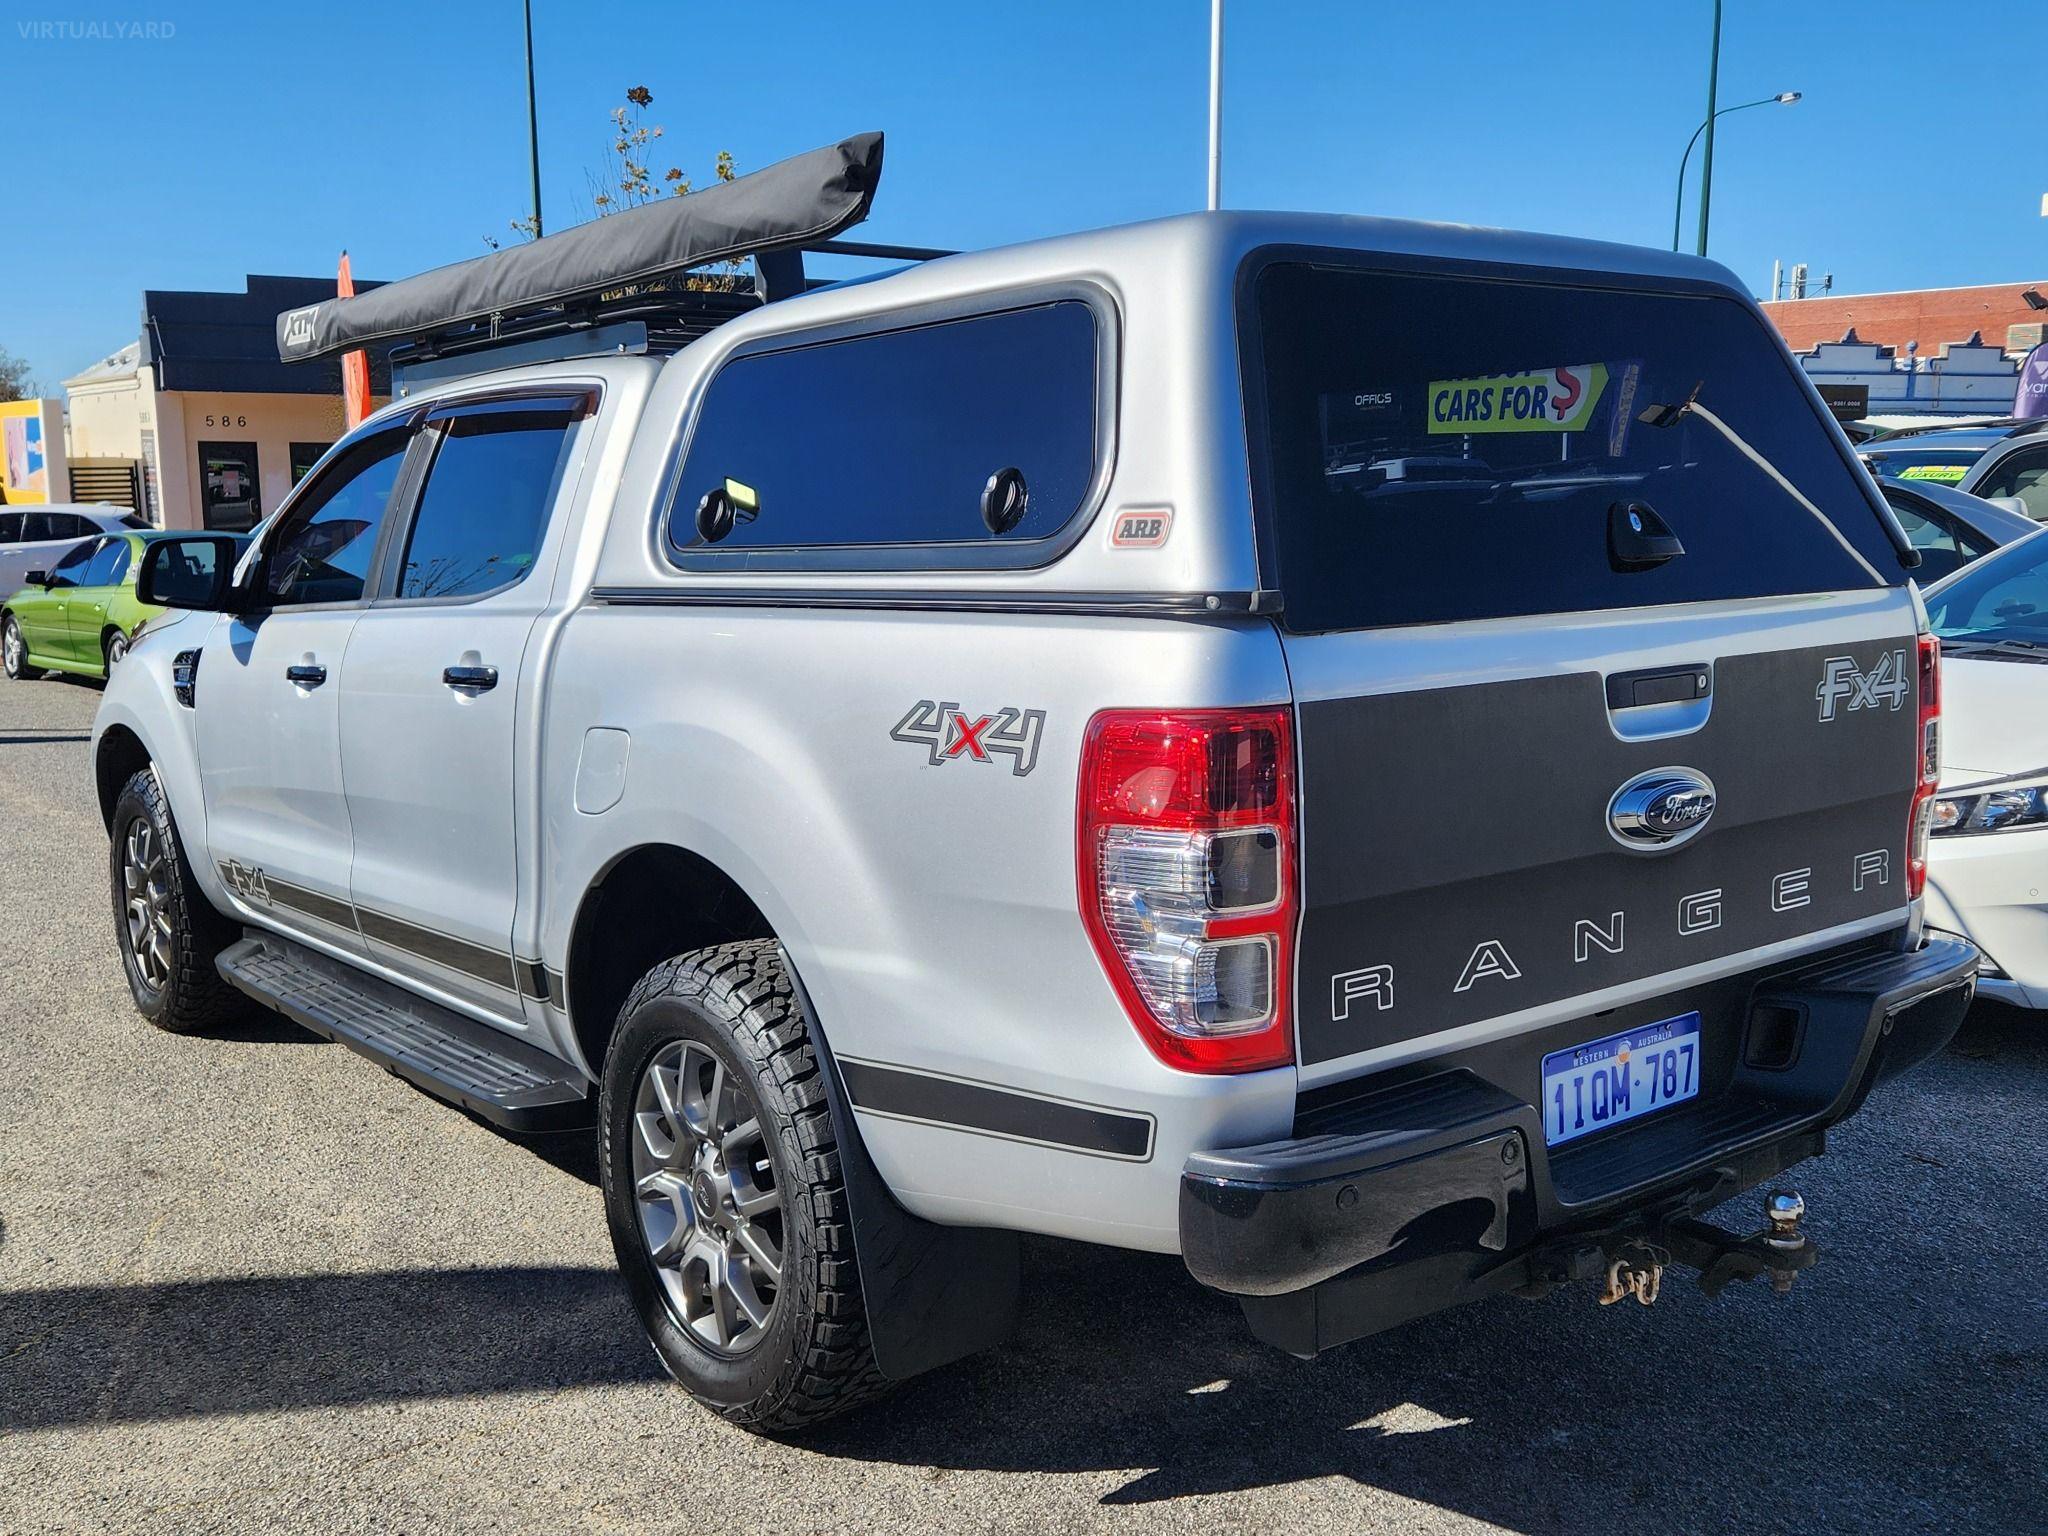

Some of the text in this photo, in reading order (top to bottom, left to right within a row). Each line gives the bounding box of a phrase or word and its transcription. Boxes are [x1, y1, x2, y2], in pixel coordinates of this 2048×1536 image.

[1434, 388, 1495, 422] CARS
[1499, 385, 1549, 421] FOR
[205, 415, 247, 428] 586
[1118, 519, 1163, 539] ARB
[1661, 793, 1712, 825] Ford
[1331, 848, 1889, 1021] RANGER
[1573, 1030, 1673, 1067] WESTERN AUSTRALIA
